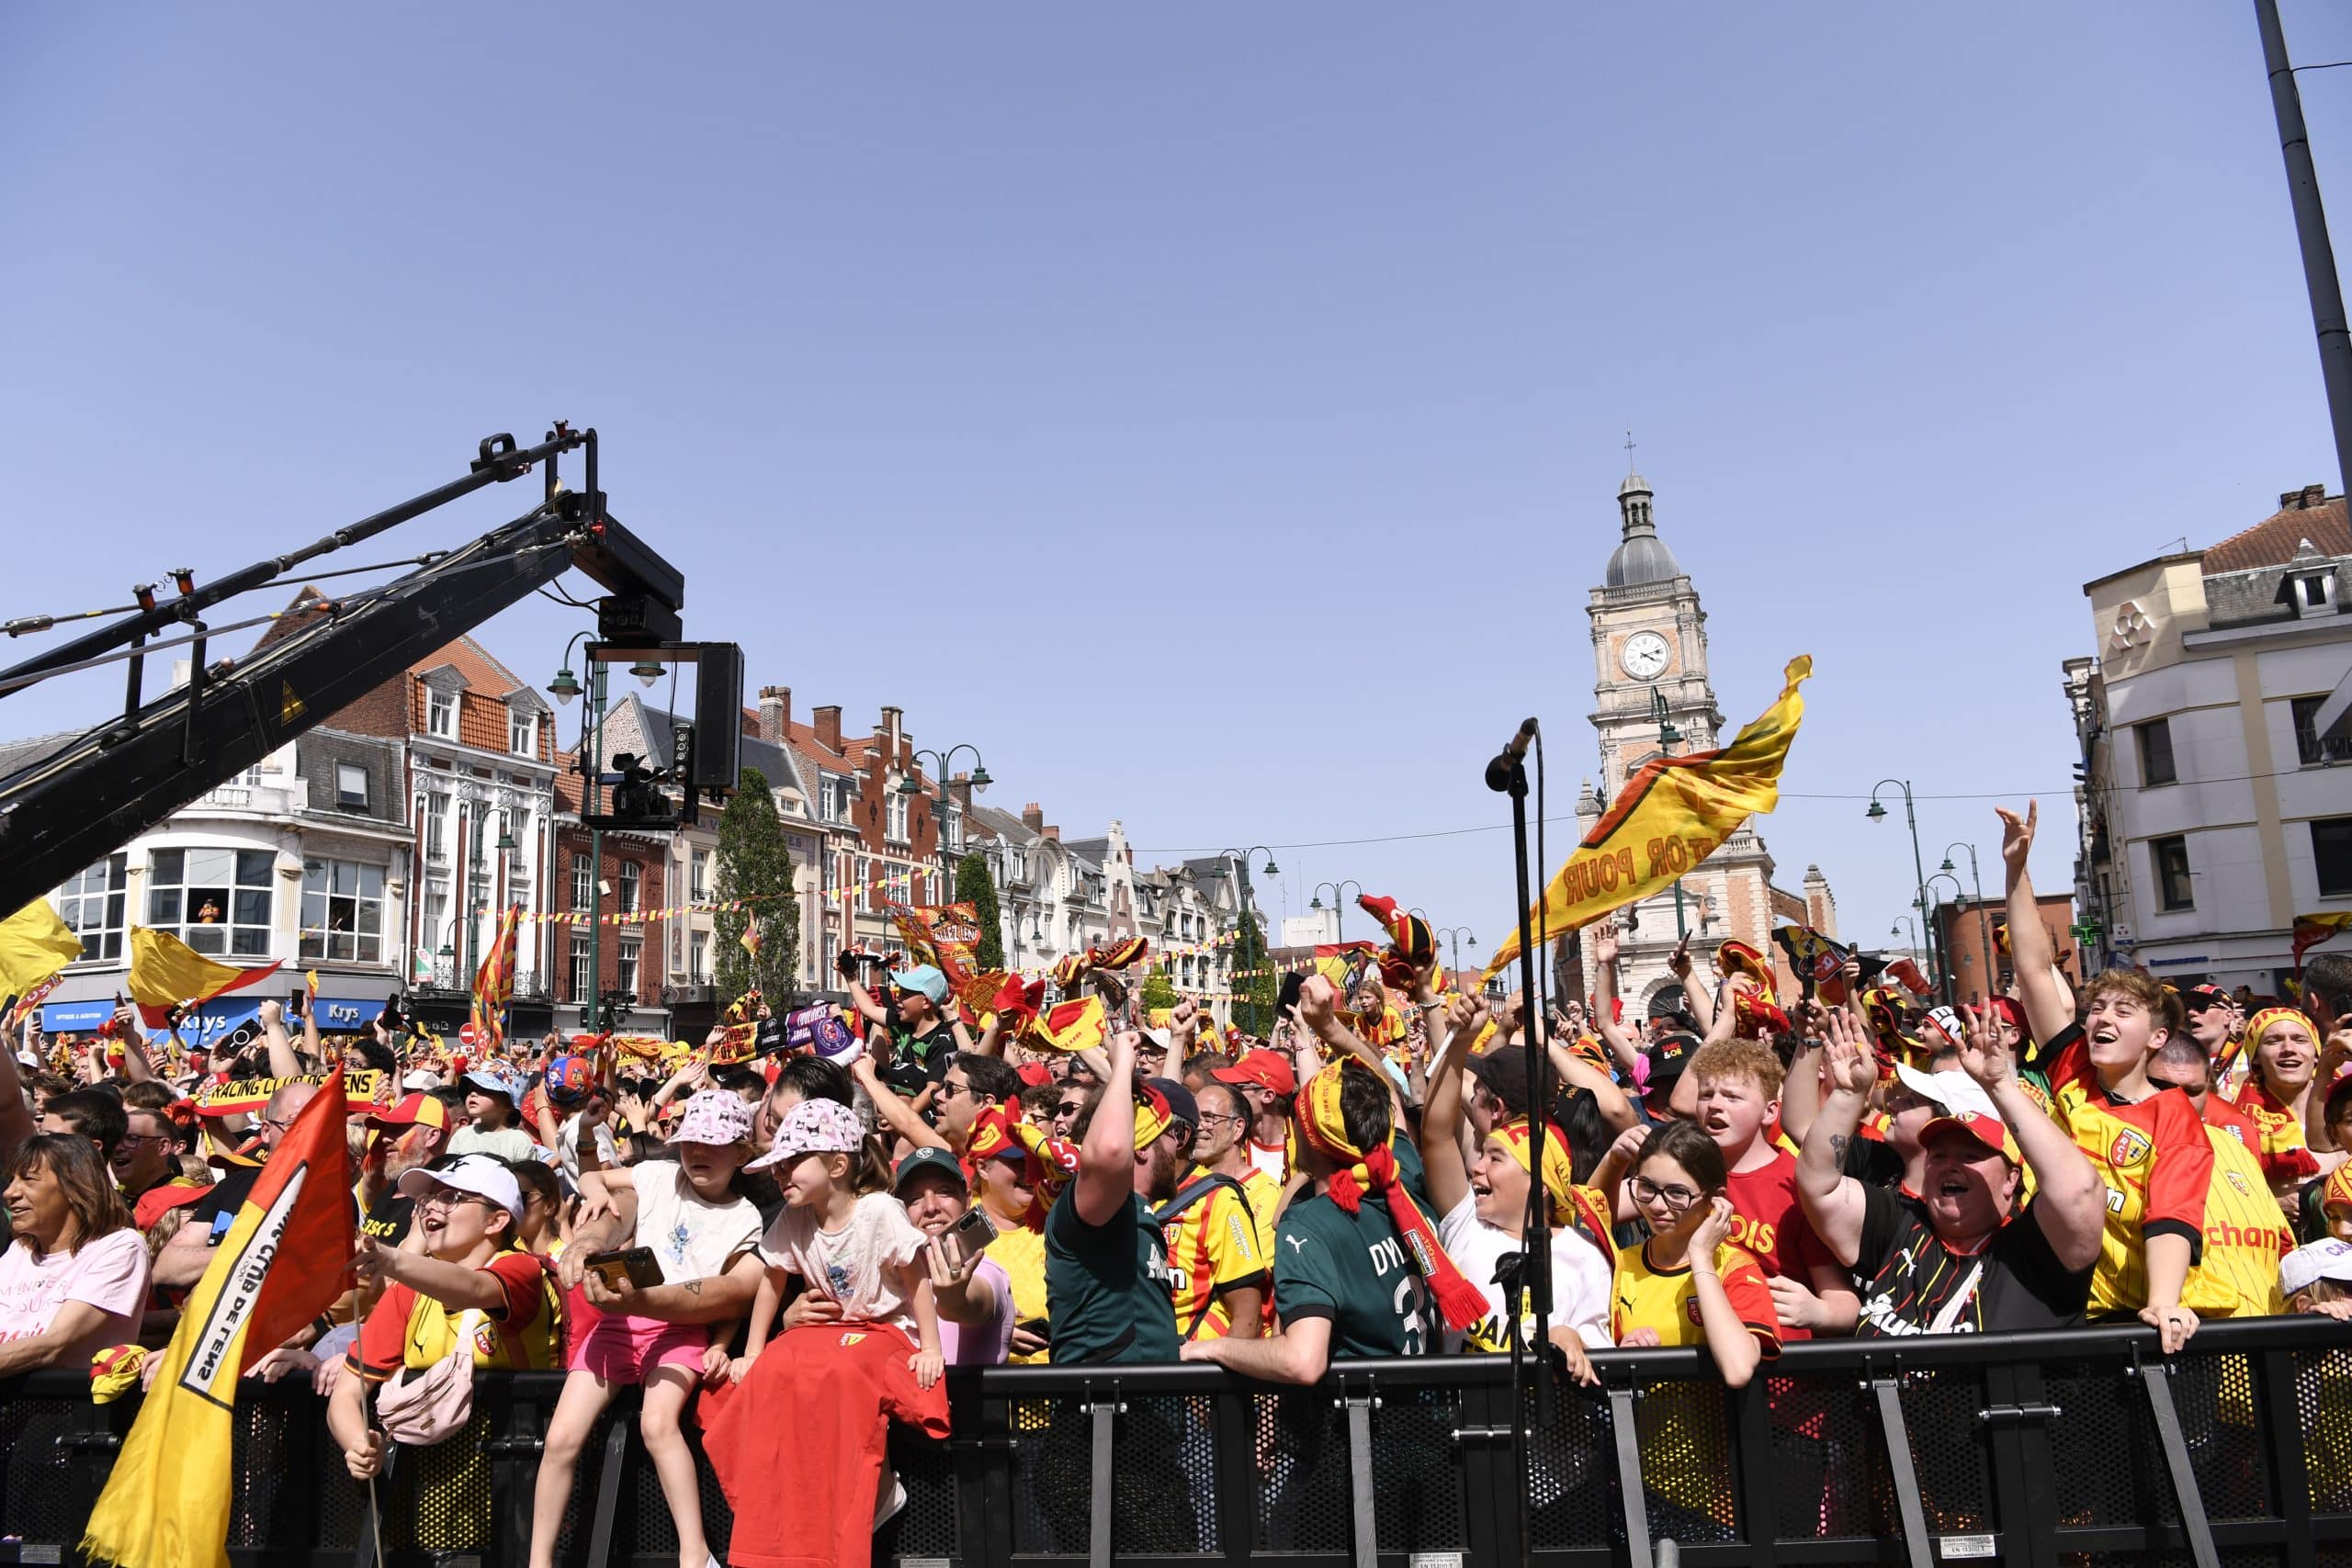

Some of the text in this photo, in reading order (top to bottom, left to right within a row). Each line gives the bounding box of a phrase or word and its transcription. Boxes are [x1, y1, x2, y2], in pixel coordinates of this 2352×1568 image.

[329, 1004, 358, 1022] Krys
[180, 1015, 226, 1033] Krys
[211, 1078, 259, 1099] RACING
[345, 1074, 372, 1094] ENS
[2204, 1220, 2278, 1250] chan
